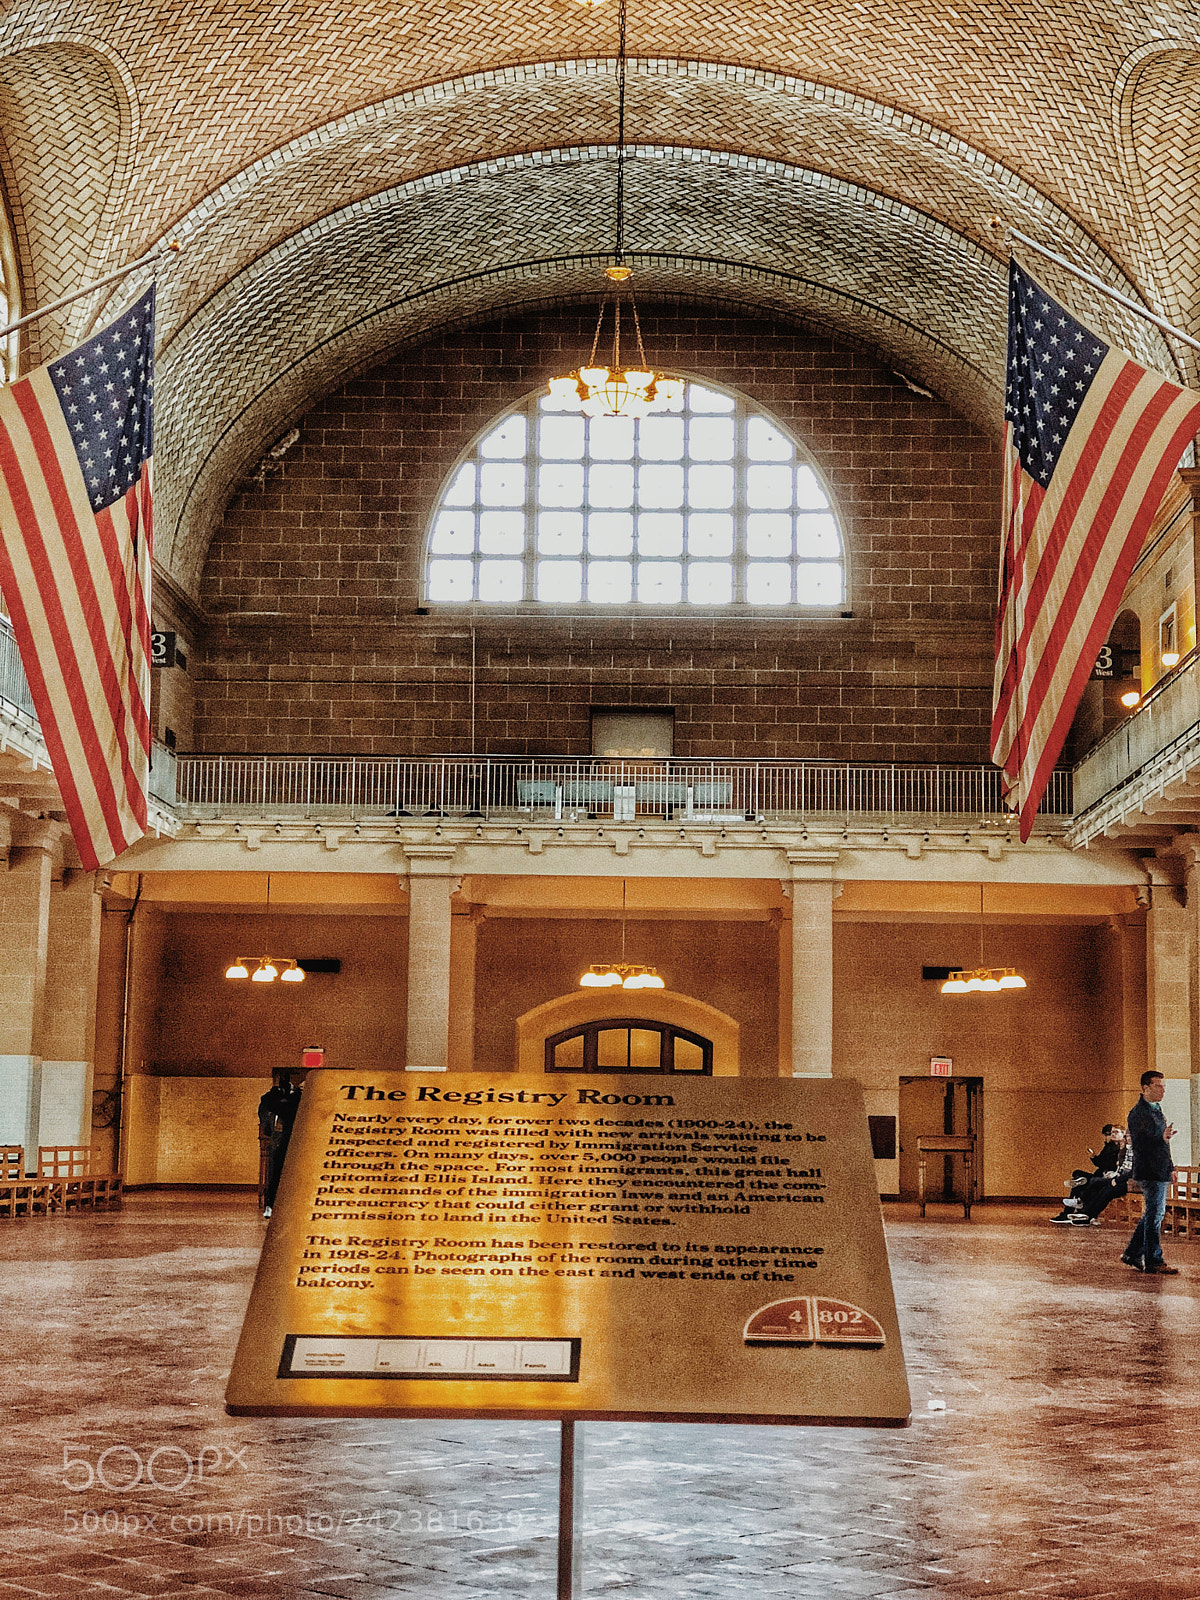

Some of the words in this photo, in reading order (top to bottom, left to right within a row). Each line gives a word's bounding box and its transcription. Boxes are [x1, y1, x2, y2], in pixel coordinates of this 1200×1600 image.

[151, 633, 167, 657] 3
[1095, 646, 1113, 669] 3
[1095, 669, 1113, 677] West
[934, 1063, 950, 1076] EXIT
[340, 1085, 406, 1101] The
[416, 1086, 568, 1107] Registry
[576, 1089, 676, 1106] Room
[334, 1113, 392, 1124] Nearly
[396, 1115, 444, 1125] every
[448, 1115, 482, 1125] day,
[488, 1116, 512, 1125] for
[516, 1118, 554, 1126] over
[558, 1118, 590, 1126] two
[594, 1118, 665, 1128] decades
[764, 1121, 792, 1130] the
[331, 1125, 407, 1136] Registry
[411, 1126, 460, 1136] Room
[466, 1128, 499, 1136] was
[504, 1128, 549, 1137] filled
[554, 1129, 593, 1138] with
[598, 1131, 633, 1139] new
[638, 1131, 709, 1140] arrivals
[713, 1132, 782, 1143] waiting
[785, 1133, 802, 1142] to
[806, 1133, 827, 1142] be
[328, 1137, 413, 1147] inspected
[417, 1138, 450, 1147] and
[454, 1139, 545, 1149] registered
[549, 1140, 570, 1150] by
[575, 1140, 690, 1151] Immigration
[691, 1143, 758, 1153] Service
[325, 1148, 398, 1158] officers.
[403, 1149, 430, 1159] On
[434, 1152, 484, 1161] many
[487, 1151, 534, 1161] days,
[582, 1153, 637, 1163] 5,000
[640, 1155, 698, 1165] people
[703, 1156, 756, 1165] would
[760, 1156, 790, 1165] file
[323, 1160, 395, 1171] through
[400, 1161, 429, 1171] the
[433, 1163, 489, 1172] space.
[495, 1163, 526, 1172] For
[529, 1165, 574, 1173] most
[578, 1165, 690, 1176] immigrants,
[695, 1167, 731, 1176] this
[734, 1167, 782, 1178] great
[786, 1168, 822, 1178] hall
[320, 1173, 419, 1183] epitomized
[424, 1174, 467, 1183] Ellis
[471, 1174, 532, 1185] Island.
[539, 1176, 583, 1186] Here
[588, 1177, 627, 1188] they
[632, 1178, 745, 1189] encountered
[750, 1180, 779, 1190] the
[783, 1181, 827, 1190] com-
[317, 1186, 354, 1195] plex
[359, 1186, 442, 1196] demands
[446, 1187, 467, 1196] of
[468, 1188, 498, 1197] the
[502, 1188, 617, 1199] immigration
[621, 1189, 666, 1200] laws
[668, 1192, 701, 1201] and
[706, 1193, 729, 1201] an
[734, 1192, 825, 1203] American
[314, 1198, 430, 1209] bureaucracy
[434, 1199, 471, 1209] that
[475, 1201, 525, 1210] could
[529, 1201, 586, 1211] either
[589, 1203, 640, 1212] grant
[644, 1205, 664, 1213] or
[669, 1204, 750, 1214] withhold
[311, 1211, 415, 1221] permission
[420, 1212, 438, 1222] to
[443, 1212, 483, 1222] land
[488, 1213, 506, 1222] in
[511, 1213, 541, 1223] the
[546, 1214, 608, 1224] United
[612, 1215, 677, 1226] States.
[306, 1235, 342, 1246] The
[347, 1236, 428, 1248] Registry
[434, 1237, 486, 1248] Room
[491, 1239, 524, 1248] has
[528, 1240, 574, 1249] been
[578, 1241, 657, 1251] restored
[662, 1242, 681, 1252] to
[686, 1242, 709, 1252] its
[714, 1244, 824, 1255] appearance
[302, 1250, 321, 1259] in
[327, 1250, 406, 1260] 1918-24.
[412, 1251, 532, 1263] Photographs
[537, 1253, 556, 1263] of
[560, 1253, 590, 1263] the
[596, 1256, 645, 1265] room
[649, 1255, 713, 1268] during
[717, 1257, 769, 1268] other
[774, 1258, 818, 1268] time
[298, 1264, 370, 1275] periods
[374, 1266, 409, 1275] can
[414, 1265, 436, 1275] be
[441, 1266, 485, 1276] seen
[490, 1268, 514, 1276] on
[519, 1267, 549, 1277] the
[554, 1268, 595, 1278] east
[600, 1269, 635, 1278] and
[640, 1271, 686, 1280] west
[690, 1271, 735, 1281] ends
[741, 1271, 763, 1281] of
[764, 1272, 795, 1282] the
[295, 1277, 375, 1290] balcony.
[788, 1310, 803, 1323] 4
[819, 1310, 863, 1324] 802
